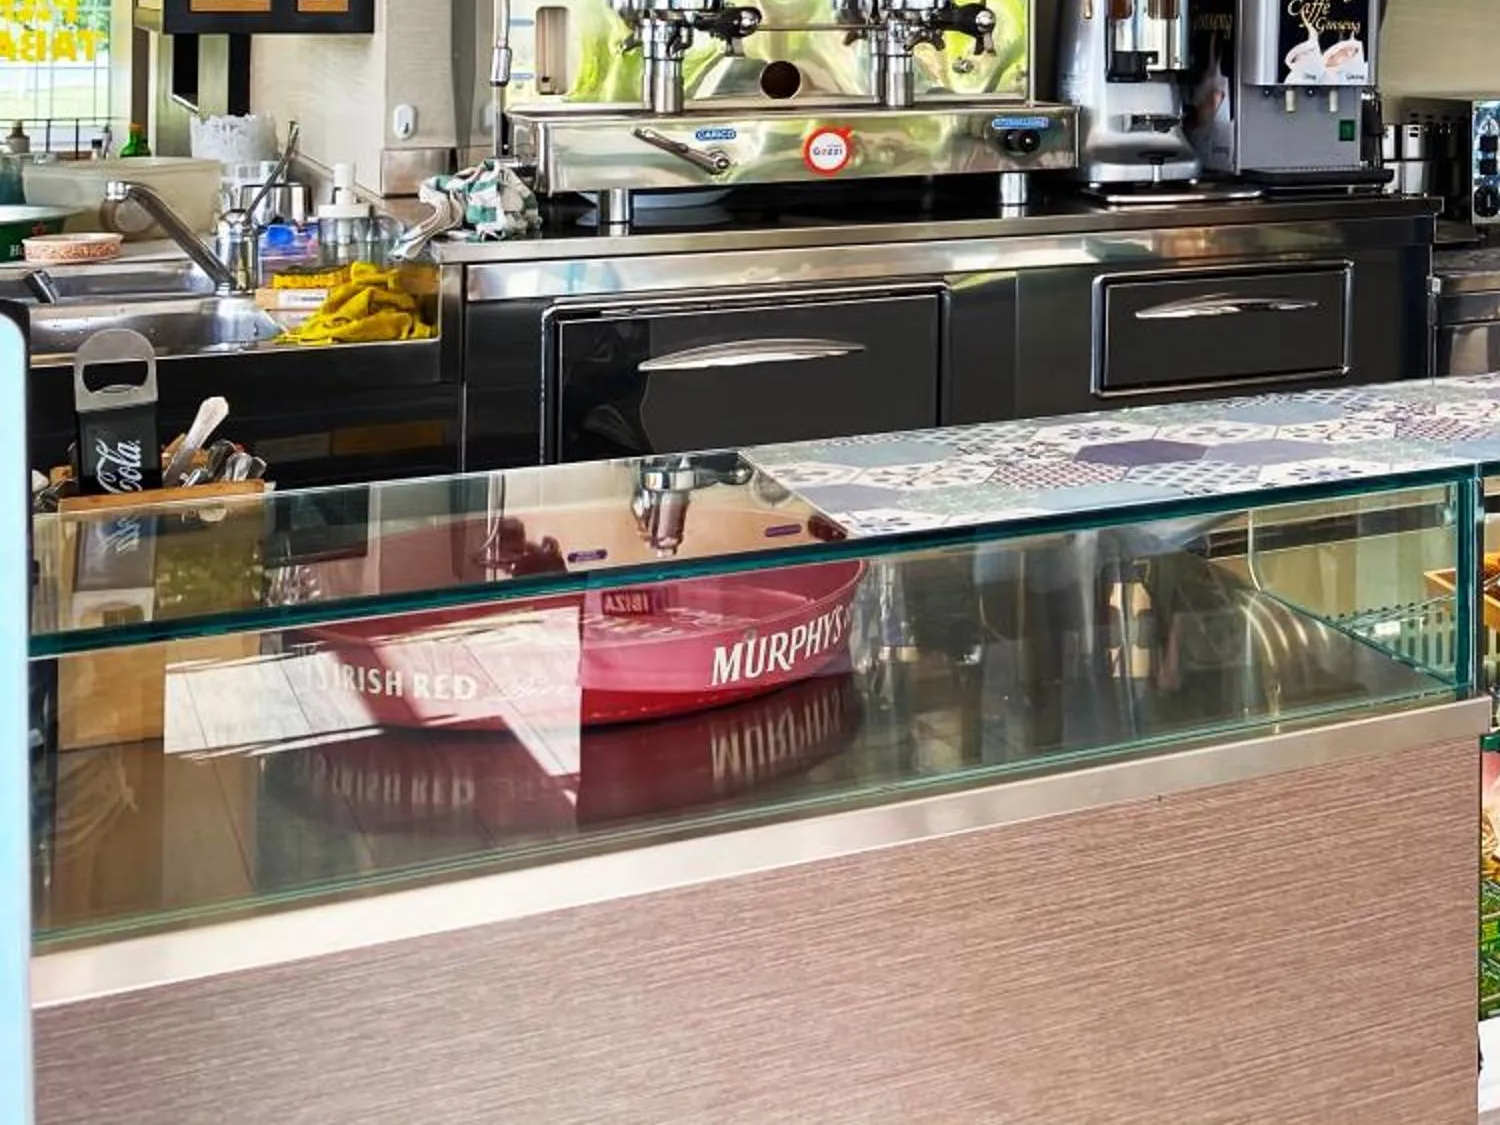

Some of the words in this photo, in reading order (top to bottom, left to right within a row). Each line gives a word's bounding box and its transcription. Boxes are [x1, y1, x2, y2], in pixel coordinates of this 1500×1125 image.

[711, 604, 844, 686] MURPHY'S
[333, 661, 403, 698] IRISH
[413, 674, 479, 700] RED
